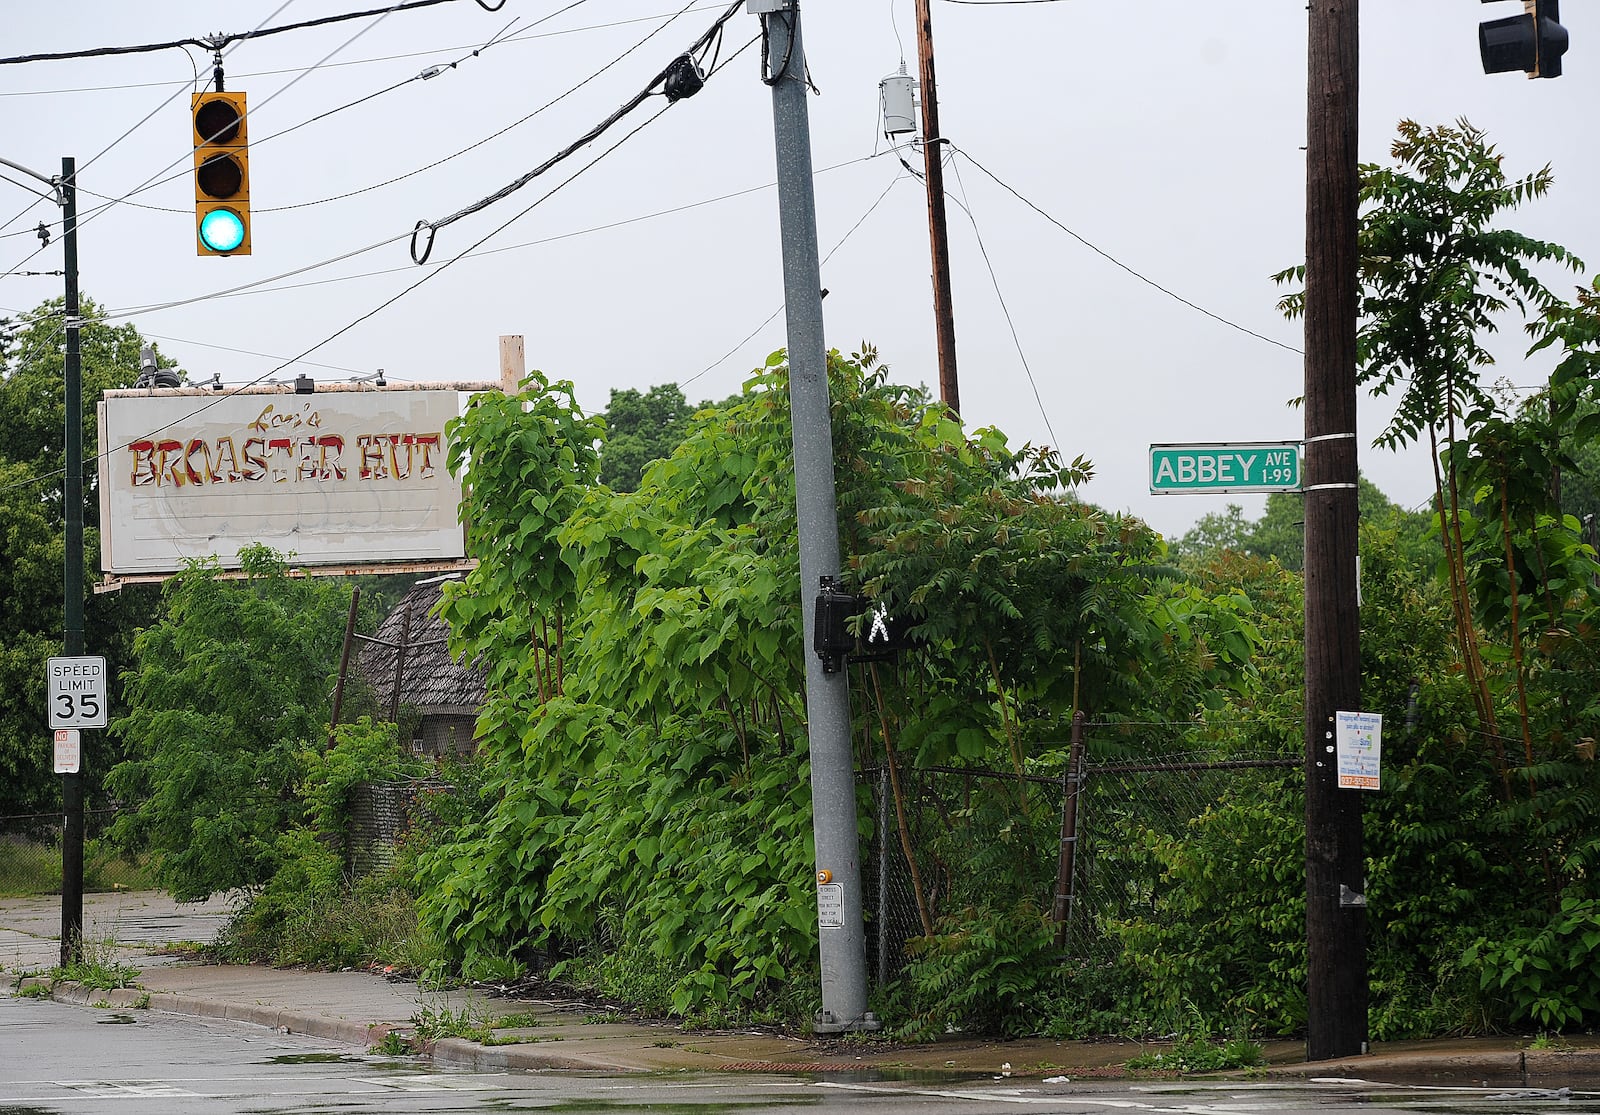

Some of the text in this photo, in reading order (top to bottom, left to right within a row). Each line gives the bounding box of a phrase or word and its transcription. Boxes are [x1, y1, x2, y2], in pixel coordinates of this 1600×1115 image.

[128, 432, 442, 488] BROASTER HUT
[1155, 452, 1291, 484] ABBEY AVE
[1262, 468, 1292, 483] 1-99
[53, 665, 100, 677] SPEED
[59, 679, 95, 691] LIMIT
[55, 693, 100, 719] 35
[56, 732, 67, 741] NO
